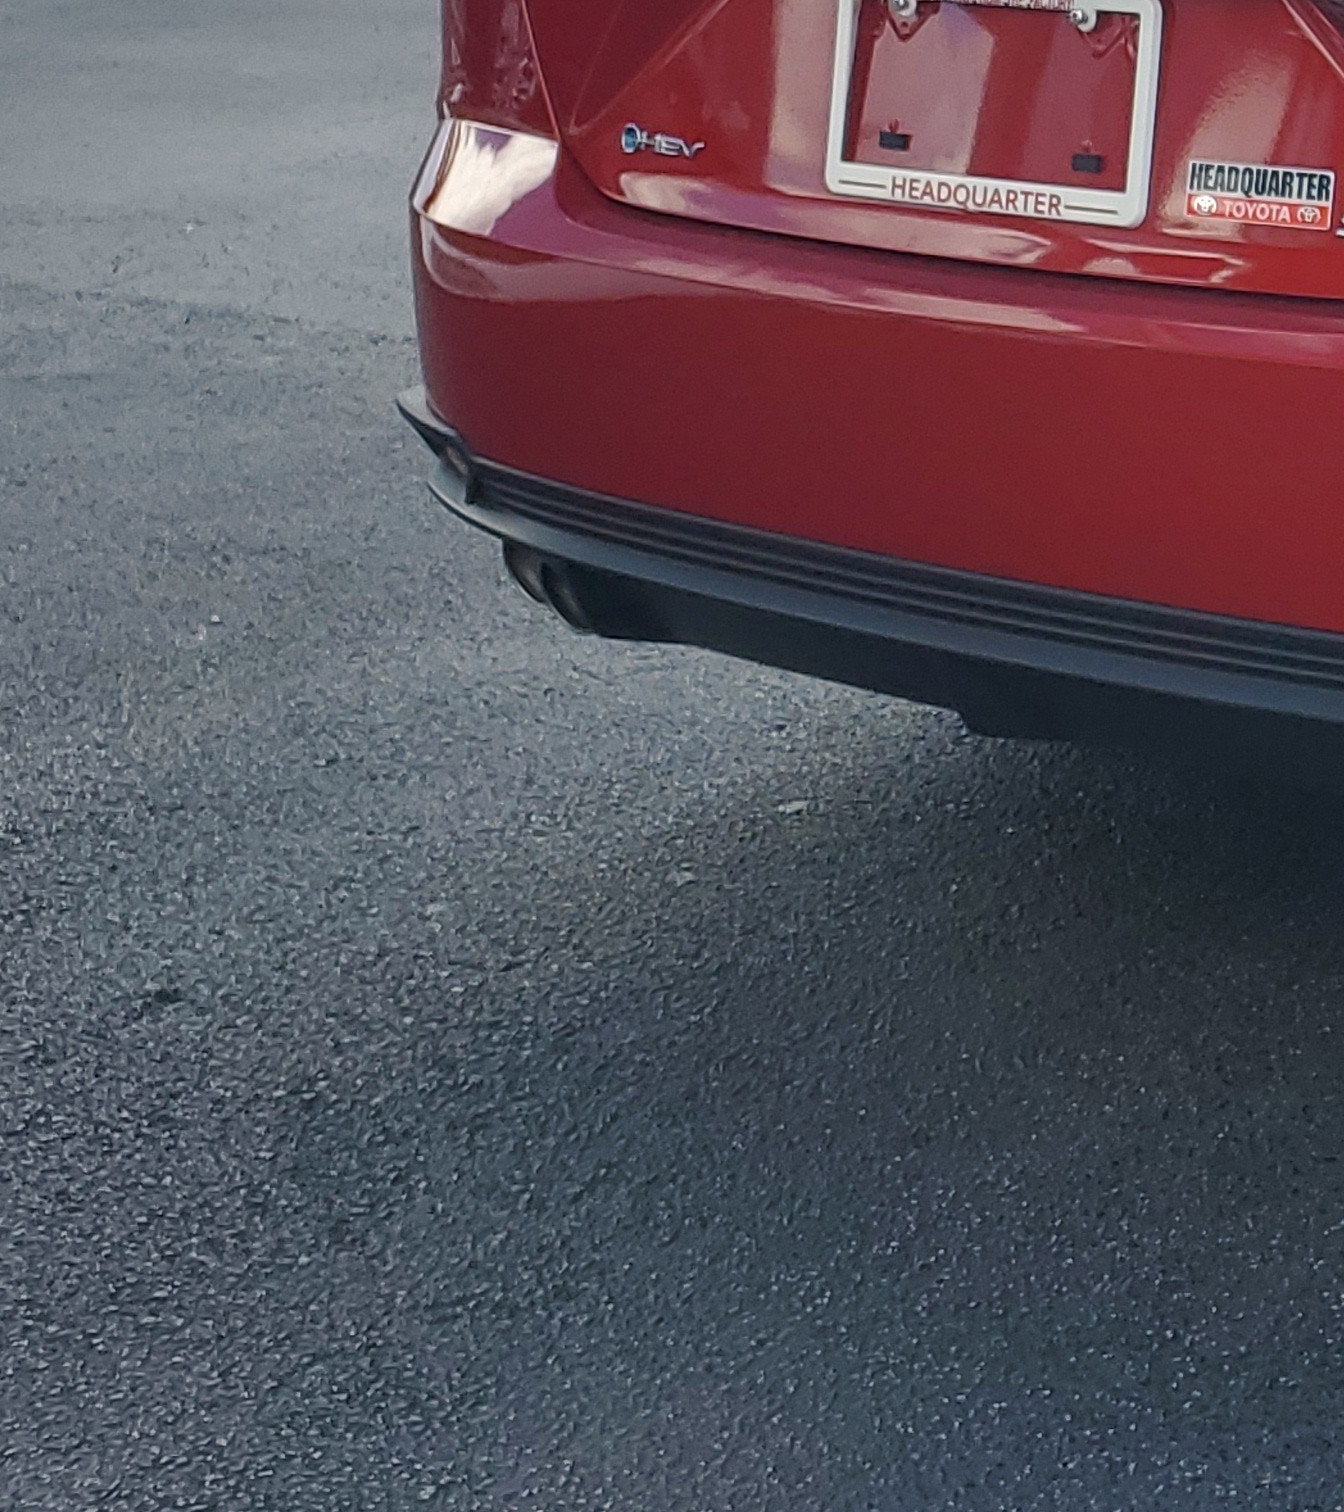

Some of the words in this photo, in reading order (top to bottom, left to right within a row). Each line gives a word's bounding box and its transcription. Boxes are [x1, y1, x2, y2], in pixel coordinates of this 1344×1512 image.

[641, 131, 705, 159] HEV
[891, 175, 1062, 217] HEADQUARTER
[1189, 162, 1332, 201] HEADQUARTER
[1224, 200, 1291, 223] TOYOTA
